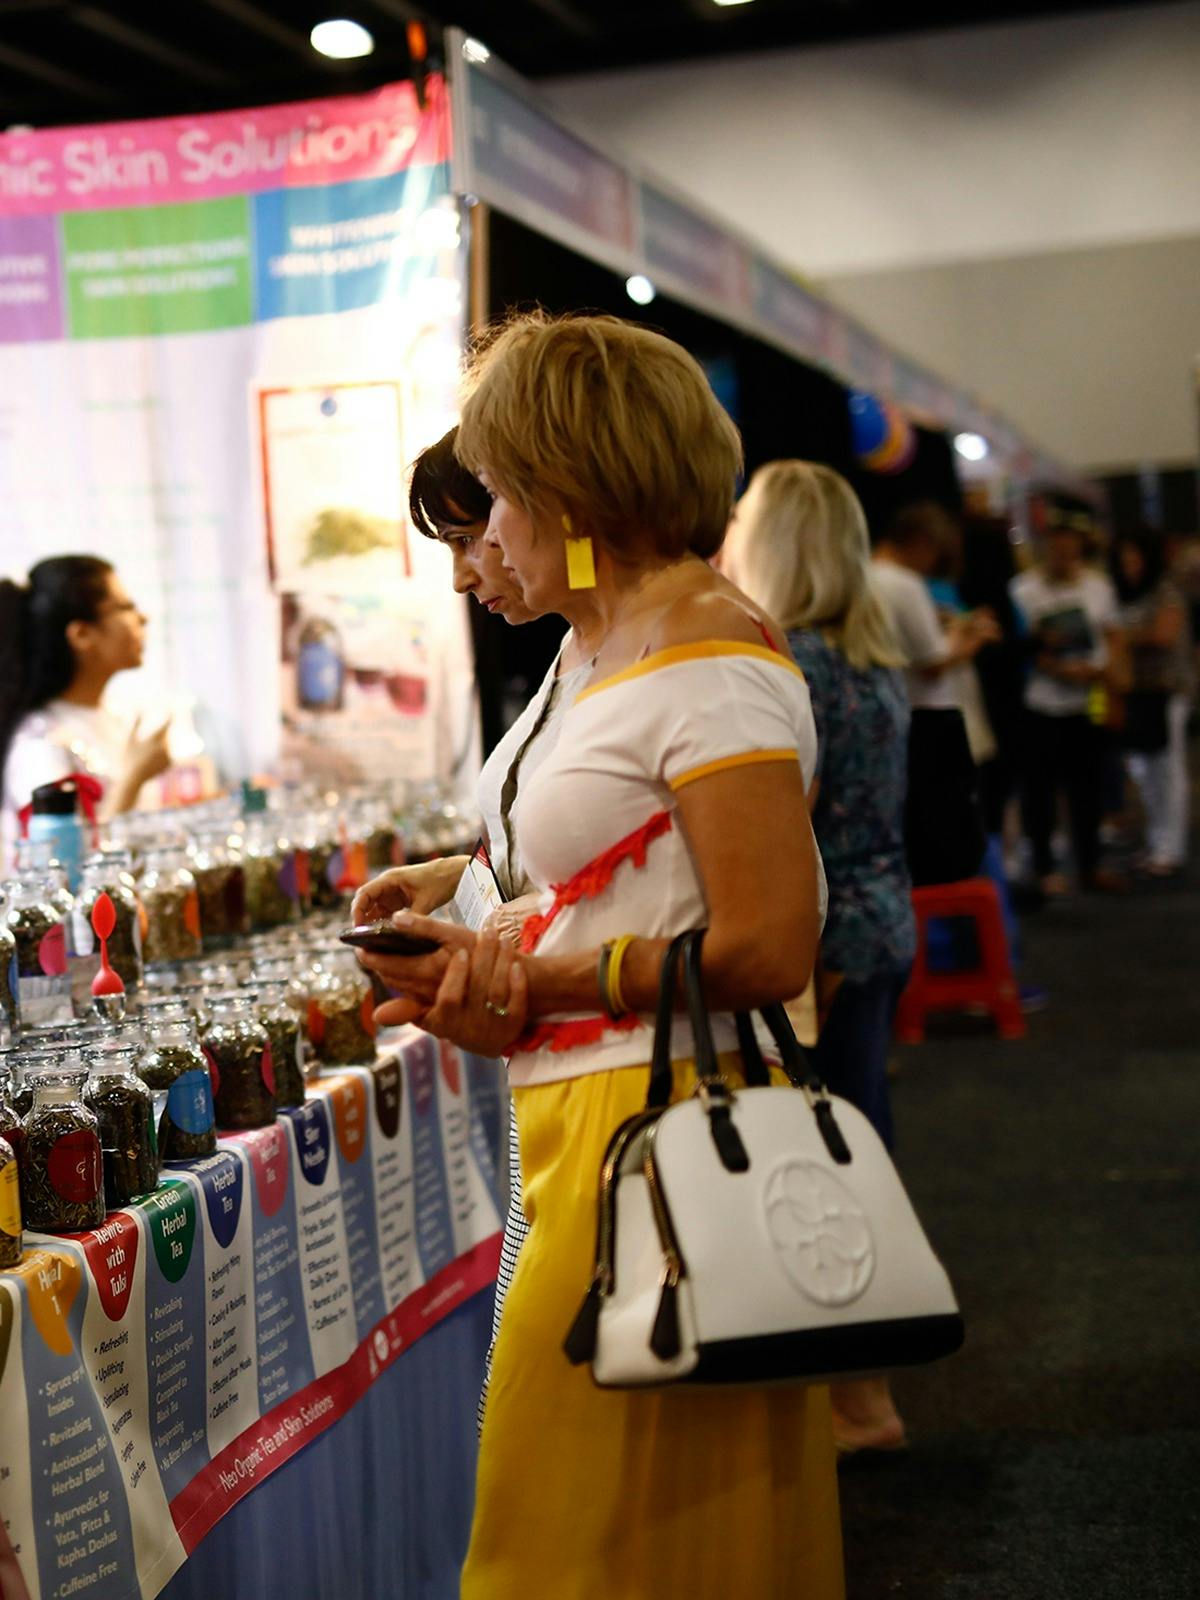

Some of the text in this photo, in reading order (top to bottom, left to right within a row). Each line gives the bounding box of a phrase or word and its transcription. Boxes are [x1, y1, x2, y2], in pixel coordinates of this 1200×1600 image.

[62, 138, 168, 193] Skin
[178, 112, 418, 182] Solutions
[212, 1165, 236, 1193] Herbal
[152, 1189, 181, 1210] Green
[222, 1196, 233, 1214] Tea
[161, 1207, 187, 1238] Herbal
[106, 1245, 125, 1270] with
[170, 1241, 183, 1260] Tea
[110, 1271, 127, 1297] Tulsi
[99, 1330, 129, 1355] Refreshing
[98, 1360, 125, 1384] Uplifting
[45, 1375, 72, 1398] Spruce
[47, 1396, 75, 1417] Insides
[49, 1416, 92, 1447] Revitalising
[219, 1395, 335, 1493] Neo Organic Tea and Skin Solutions
[52, 1459, 105, 1496] Herbal Blend
[54, 1489, 110, 1527] Ayurvedic for
[56, 1524, 79, 1547] Vata,
[81, 1517, 103, 1537] Pitta
[57, 1529, 119, 1569] Kapha Doshas
[60, 1561, 119, 1597] Caffeine Free
